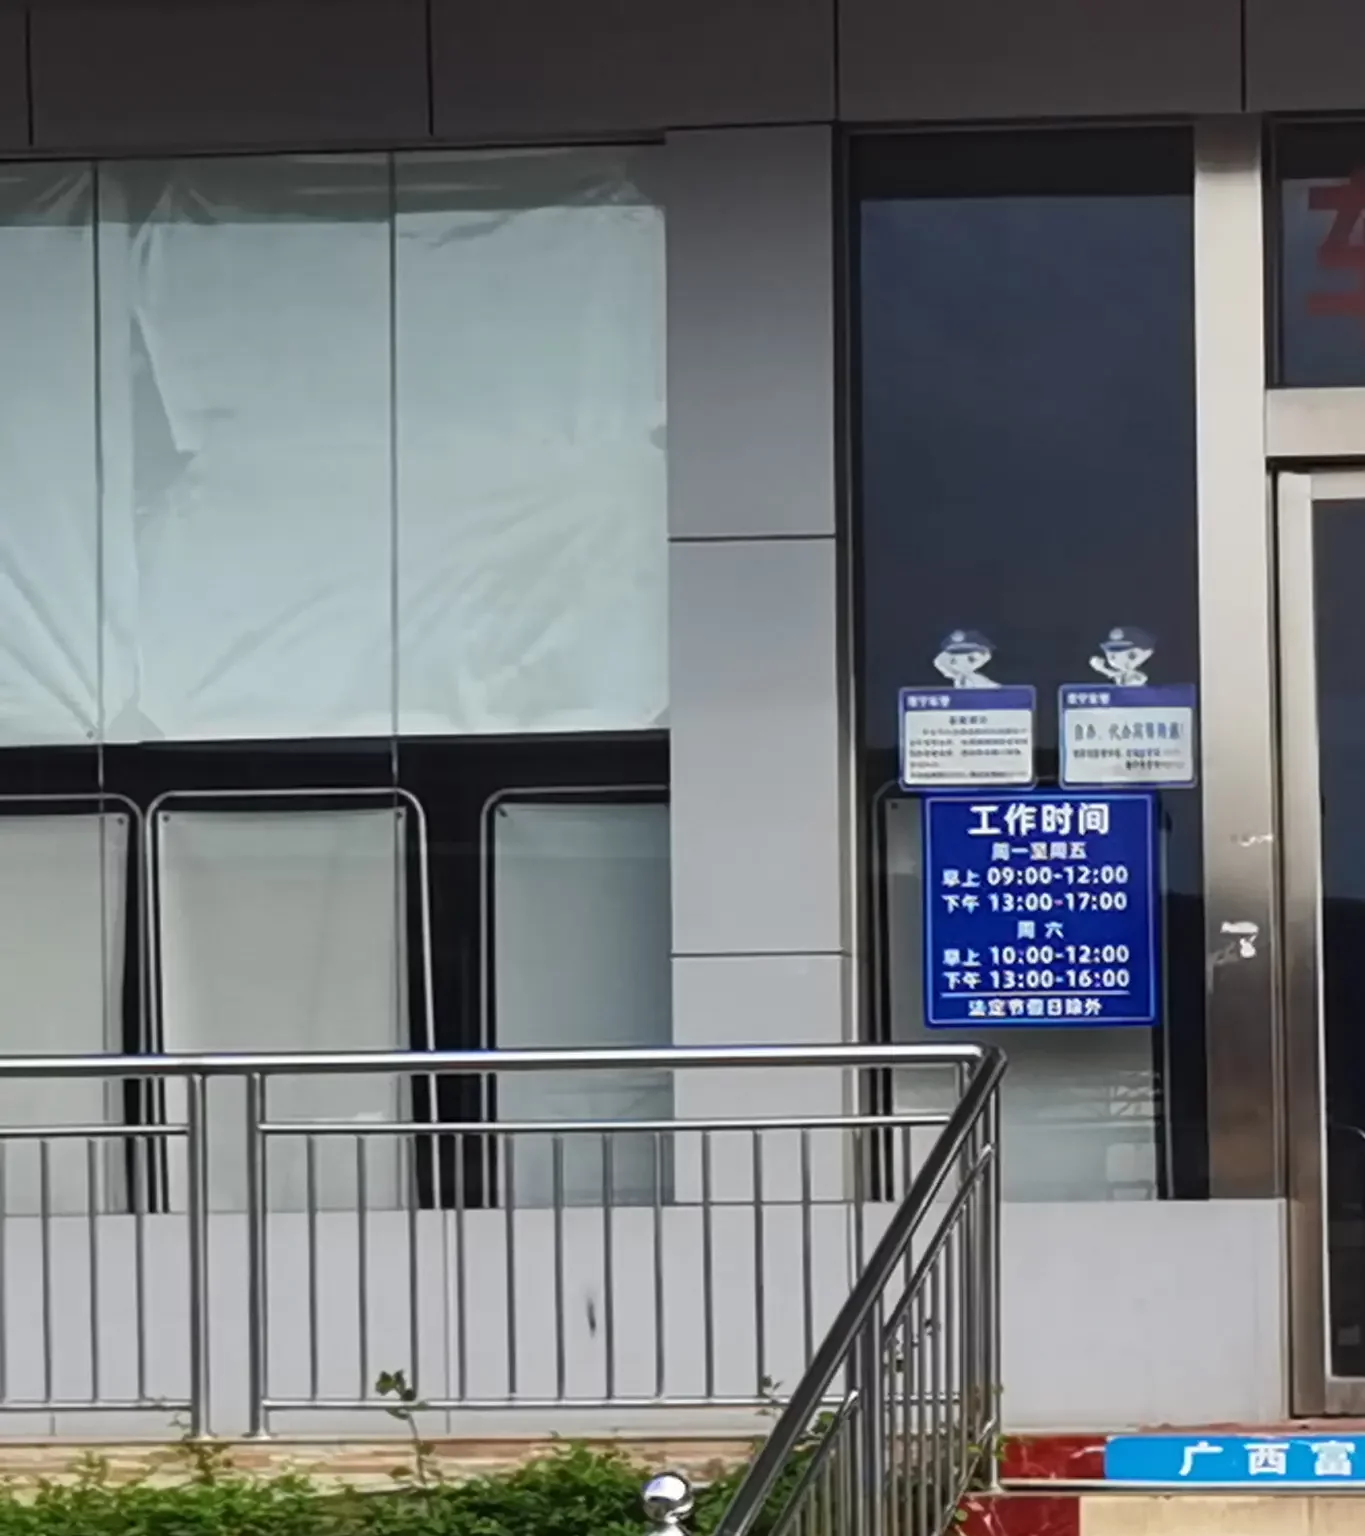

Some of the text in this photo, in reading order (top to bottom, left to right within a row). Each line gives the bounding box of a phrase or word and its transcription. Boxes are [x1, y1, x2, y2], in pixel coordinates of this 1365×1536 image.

[967, 803, 1110, 836] 工作时间
[991, 841, 1087, 861] 周一至周五
[942, 865, 1129, 887] 早上 09:00-12:00
[941, 891, 1128, 913] 下午 13:00-17:00
[943, 945, 1130, 967] 早上 10:00-12:00
[943, 969, 1130, 989] 下午 13:00-16:00
[968, 998, 1103, 1016] 法定节假日除外
